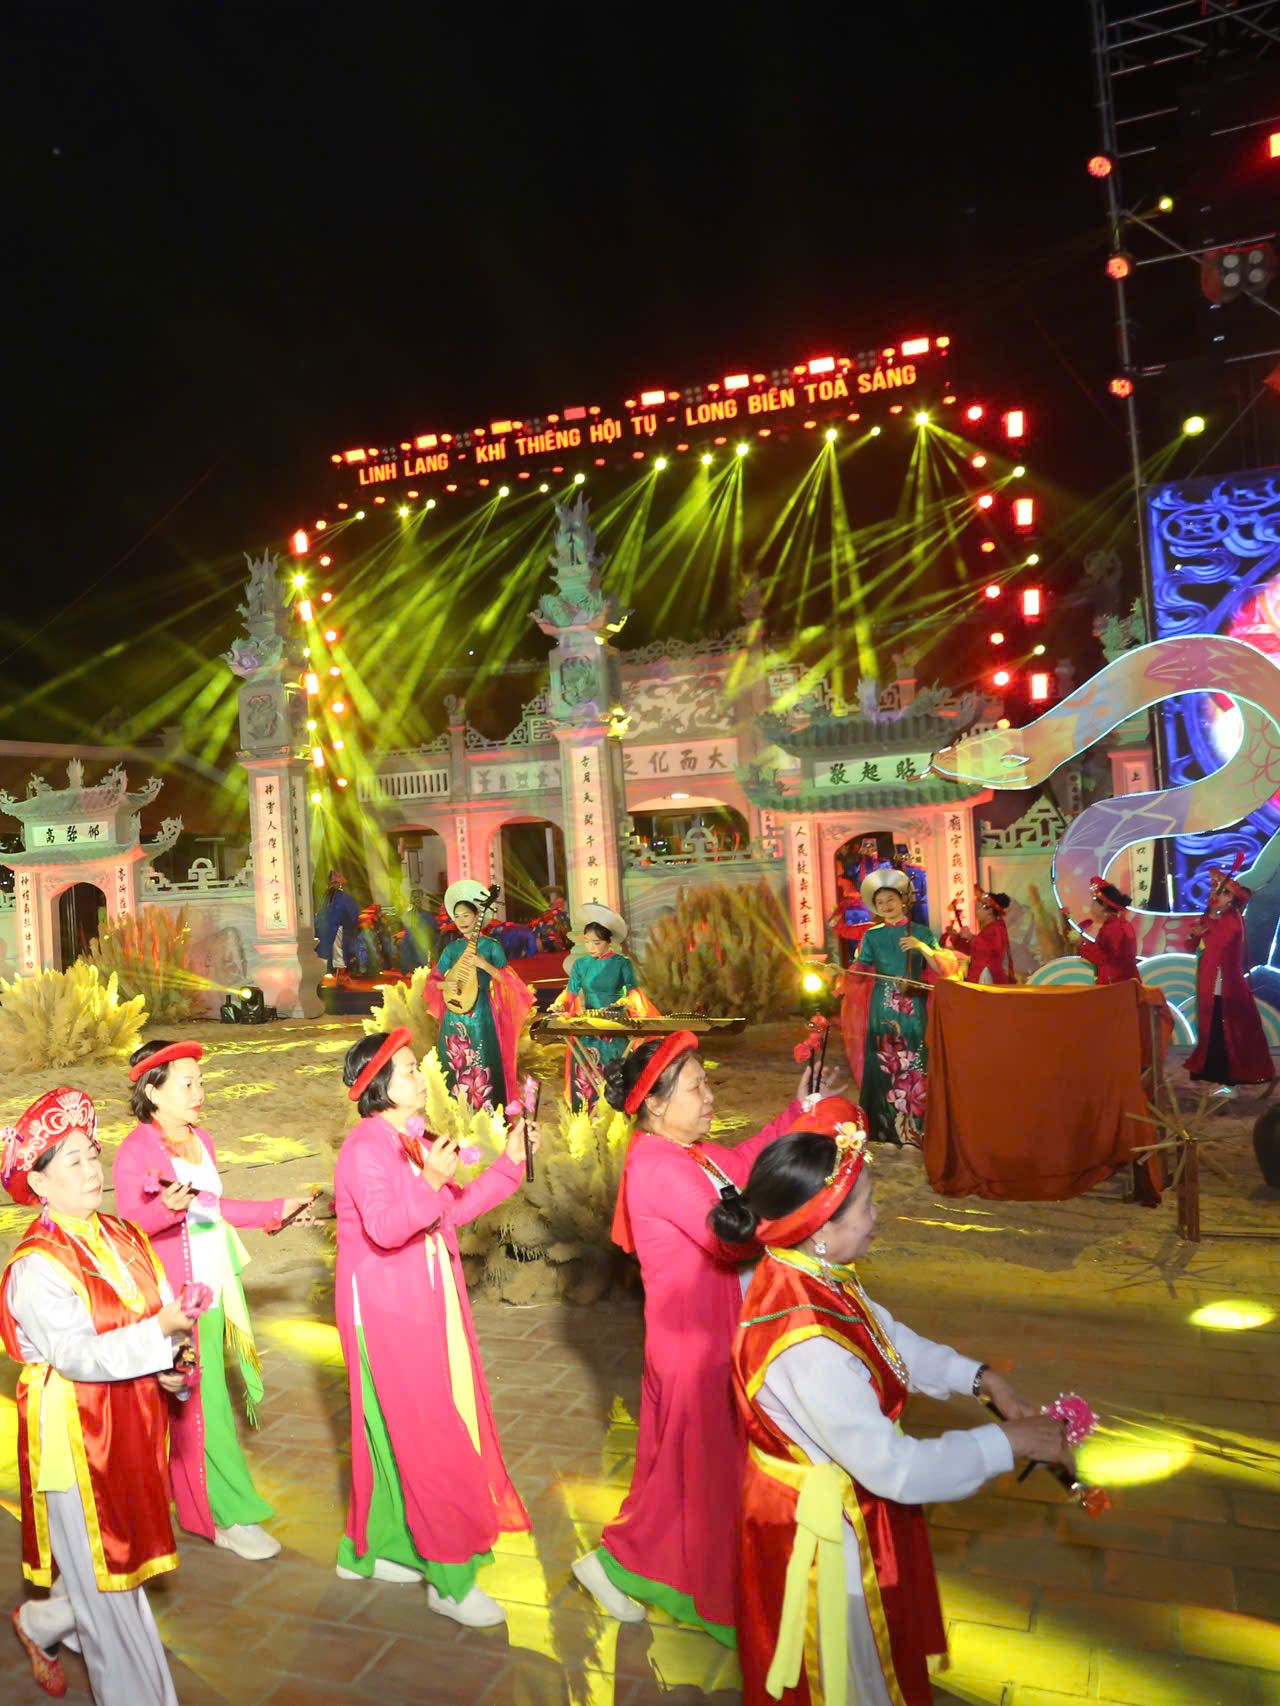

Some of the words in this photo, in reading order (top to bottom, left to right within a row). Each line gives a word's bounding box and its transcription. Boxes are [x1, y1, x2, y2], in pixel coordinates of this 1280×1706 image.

[359, 462, 397, 485] LINH
[404, 453, 448, 477] LANG
[475, 438, 507, 464] KHÍ
[515, 427, 581, 456] THIÊNG
[589, 417, 622, 443] HỘI
[630, 414, 657, 437] TỤ
[685, 398, 738, 426] LONG
[748, 386, 796, 415] BIÊN
[857, 363, 917, 394] SÁNG
